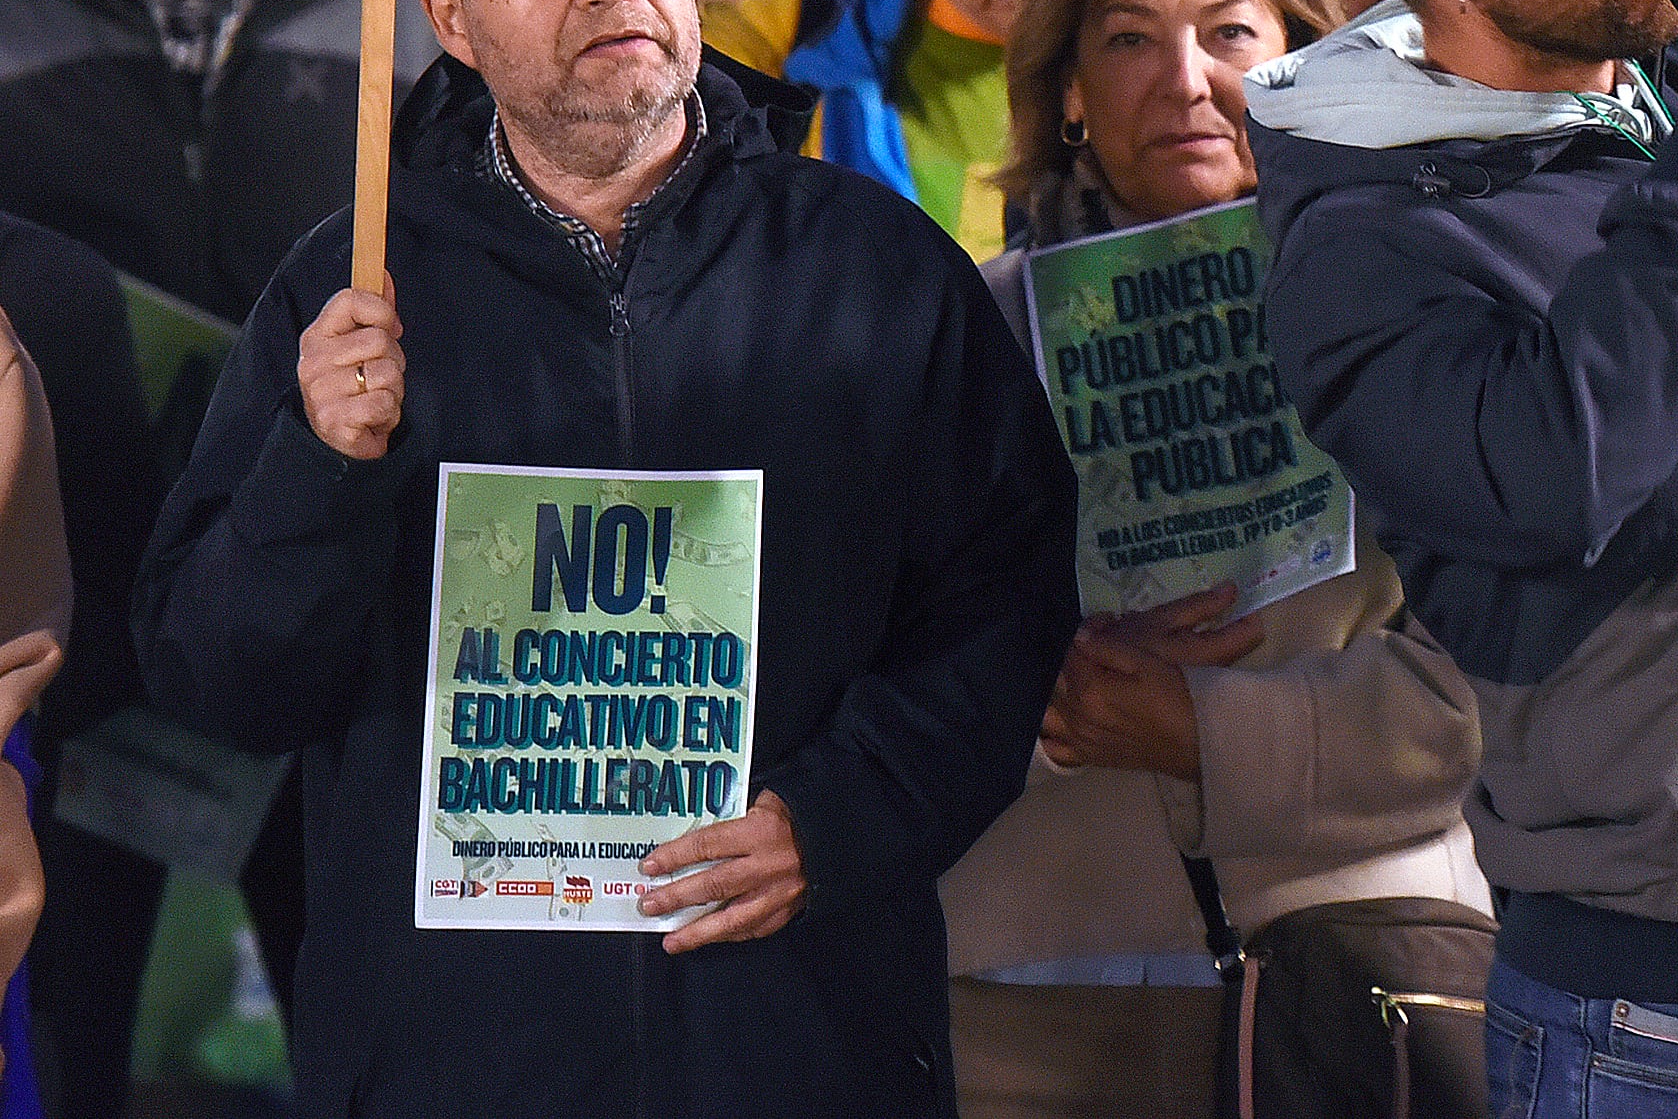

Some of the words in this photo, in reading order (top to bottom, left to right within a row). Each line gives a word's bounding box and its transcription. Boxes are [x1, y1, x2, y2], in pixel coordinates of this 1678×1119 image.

[1112, 246, 1258, 324] DINERO
[1057, 307, 1221, 395] PÚBLICO
[1066, 401, 1123, 458] LA
[531, 502, 673, 615] NO!
[453, 626, 508, 685] AL
[512, 628, 745, 689] CONCIERTO
[450, 691, 679, 750] EDUCATIVO
[682, 695, 740, 754] EN
[437, 756, 739, 818] BACHILLERATO
[452, 840, 496, 858] DINERO
[498, 837, 548, 859] PÚBLICO
[550, 841, 580, 859] PARA
[582, 842, 596, 860] LA
[599, 838, 660, 860] EDUCACIÓ
[604, 883, 633, 896] UGT
